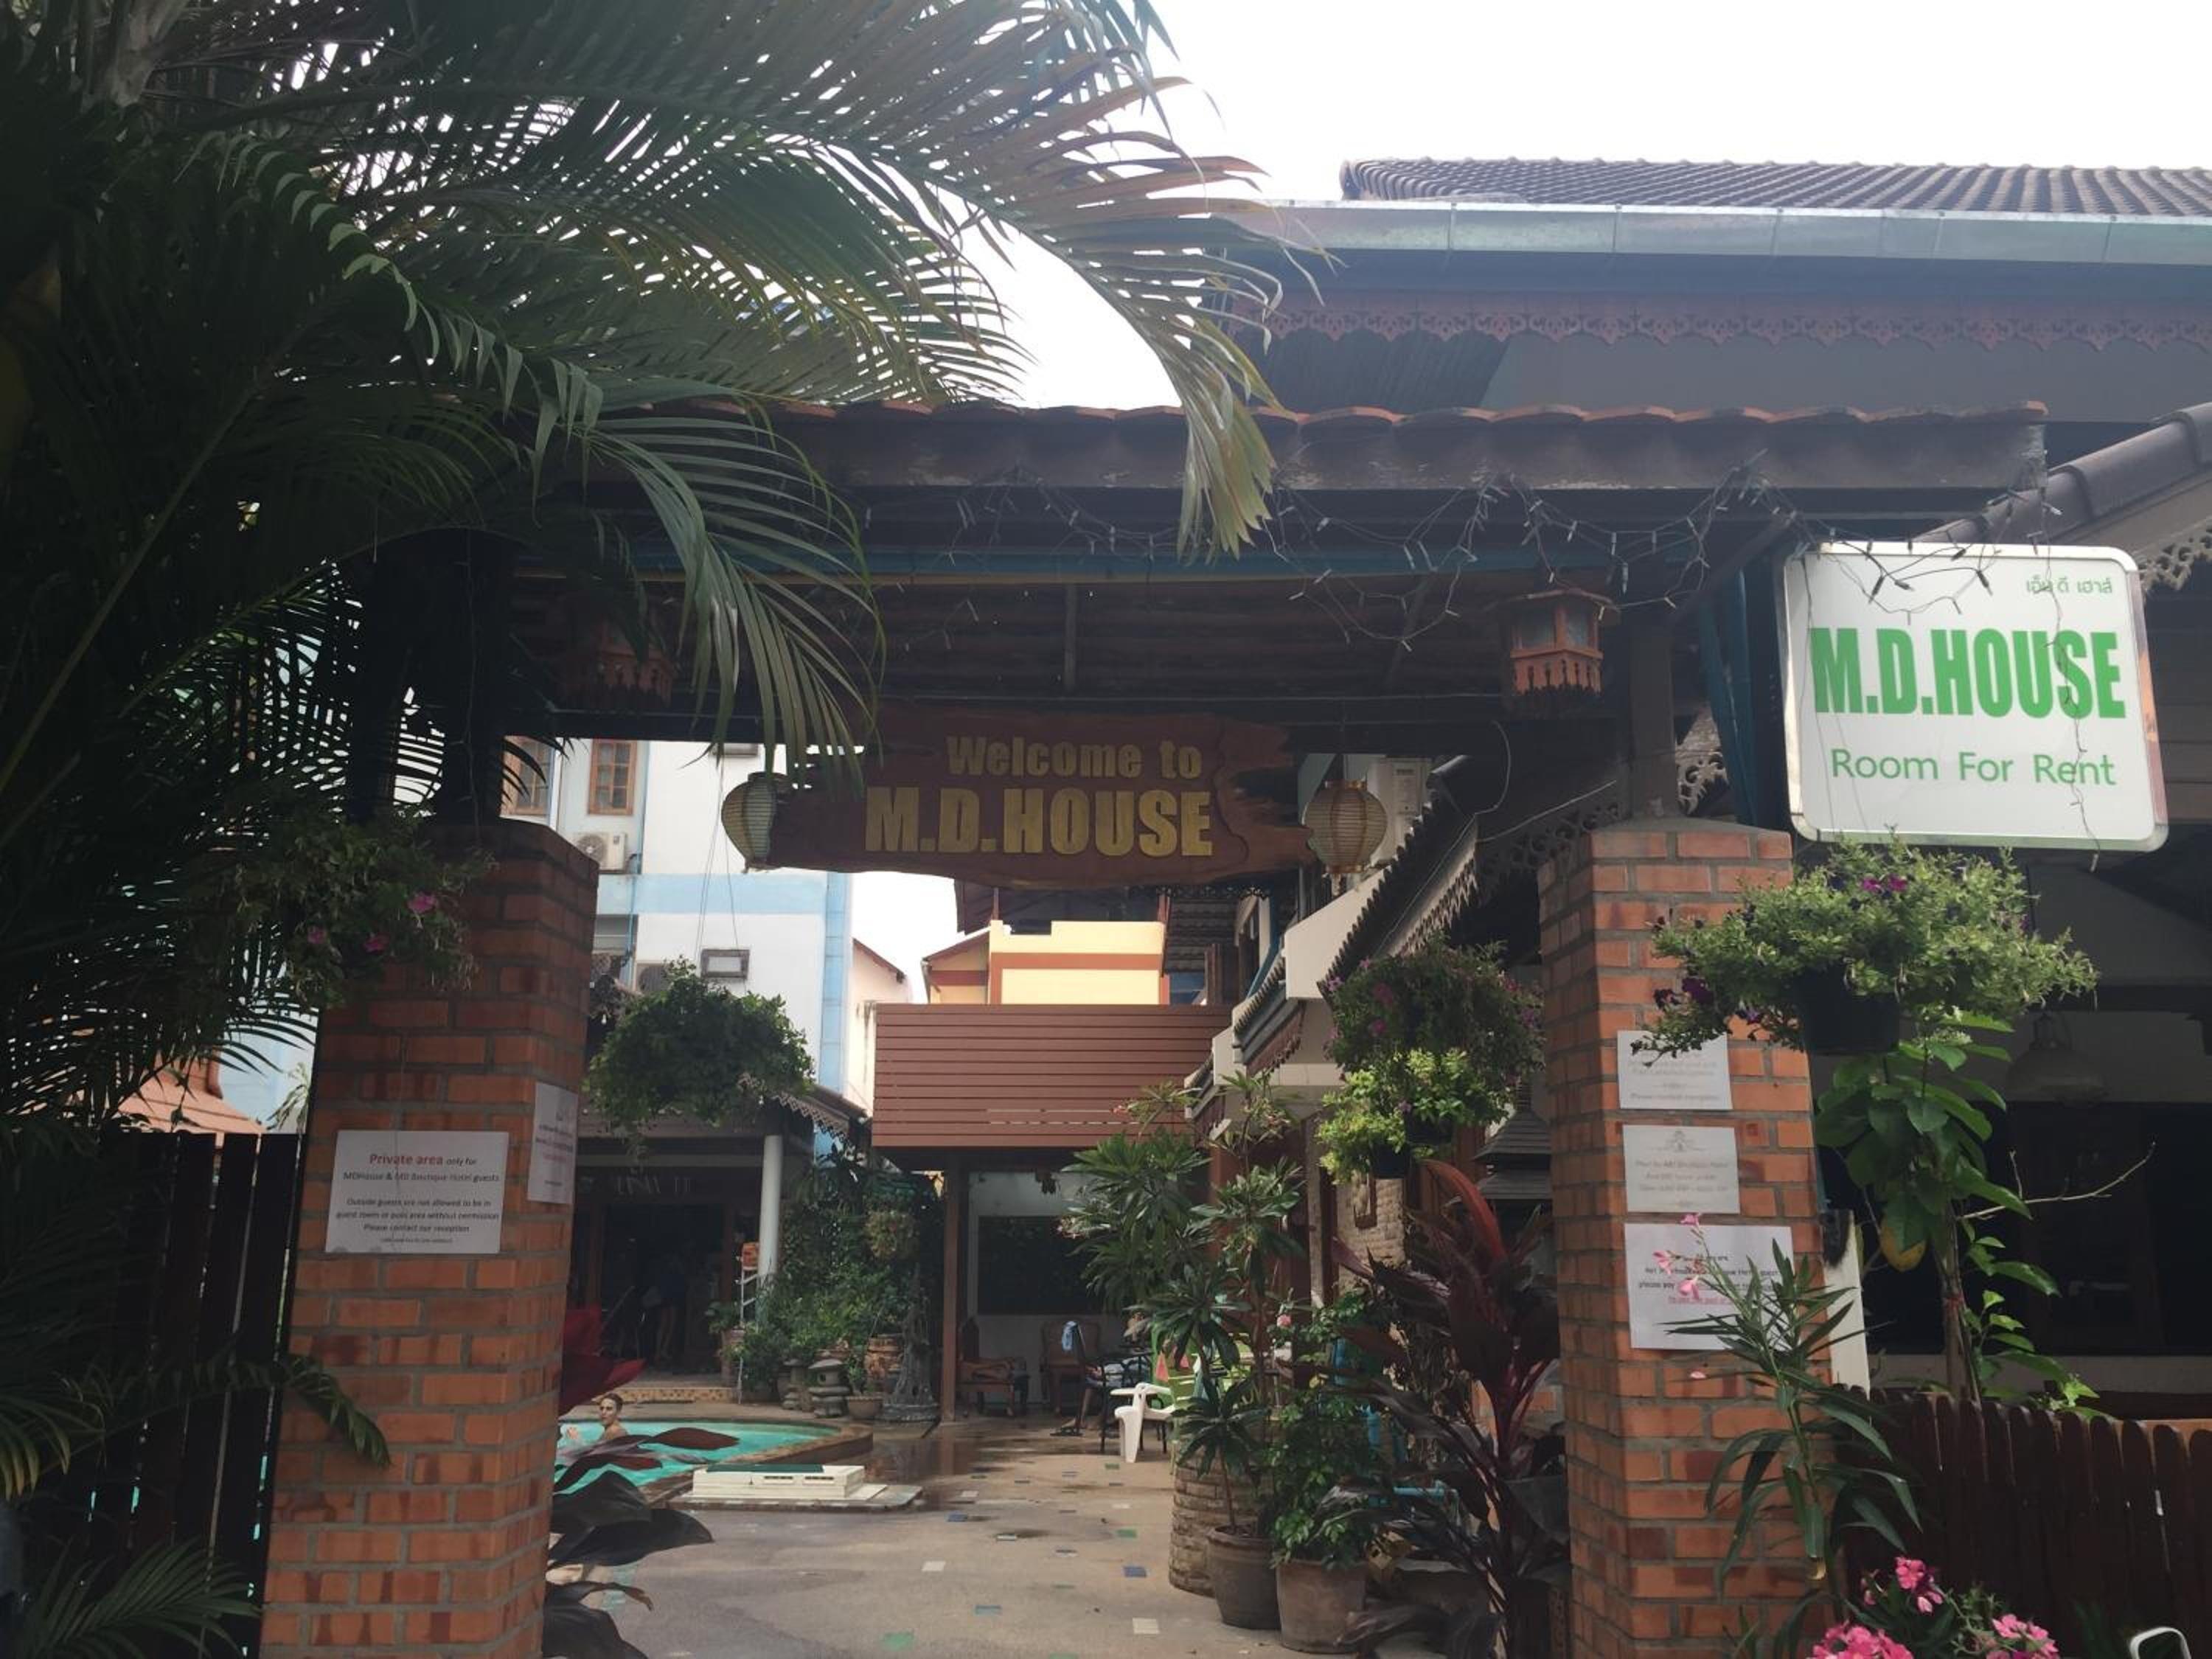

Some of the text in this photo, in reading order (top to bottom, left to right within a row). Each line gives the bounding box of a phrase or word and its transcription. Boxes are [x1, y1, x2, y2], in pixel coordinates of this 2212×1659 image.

[2056, 576, 2069, 592] ดี
[1808, 627, 2126, 719] M.D.HOUSE
[946, 736, 1203, 779] Welcome to
[1830, 748, 2116, 786] Room For Rent
[864, 786, 1213, 858] M.D.HOUSE
[369, 1153, 477, 1167] Private area only for
[386, 1171, 393, 1180] &
[473, 1172, 500, 1183] guests
